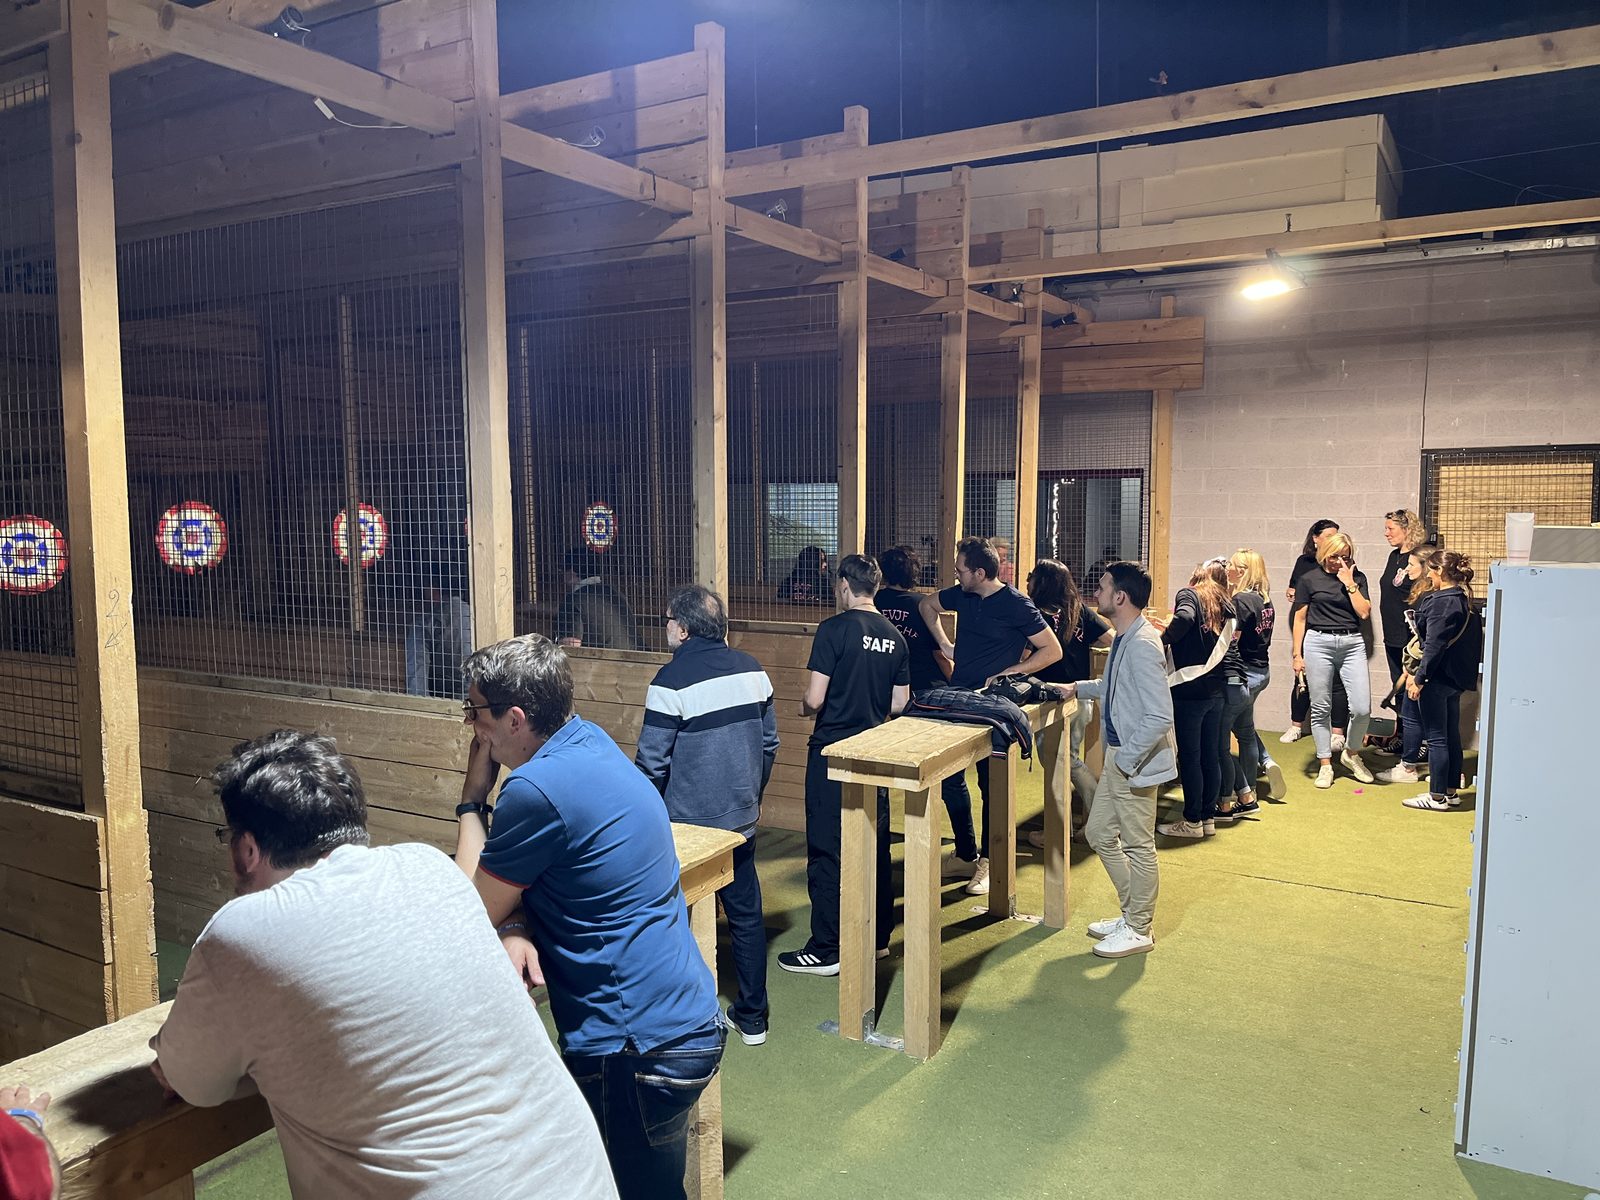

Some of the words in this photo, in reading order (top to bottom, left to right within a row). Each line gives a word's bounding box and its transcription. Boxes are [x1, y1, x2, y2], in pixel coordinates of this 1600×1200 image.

[106, 589, 120, 618] 2
[882, 609, 909, 621] EVJF
[862, 635, 896, 654] STAFF
